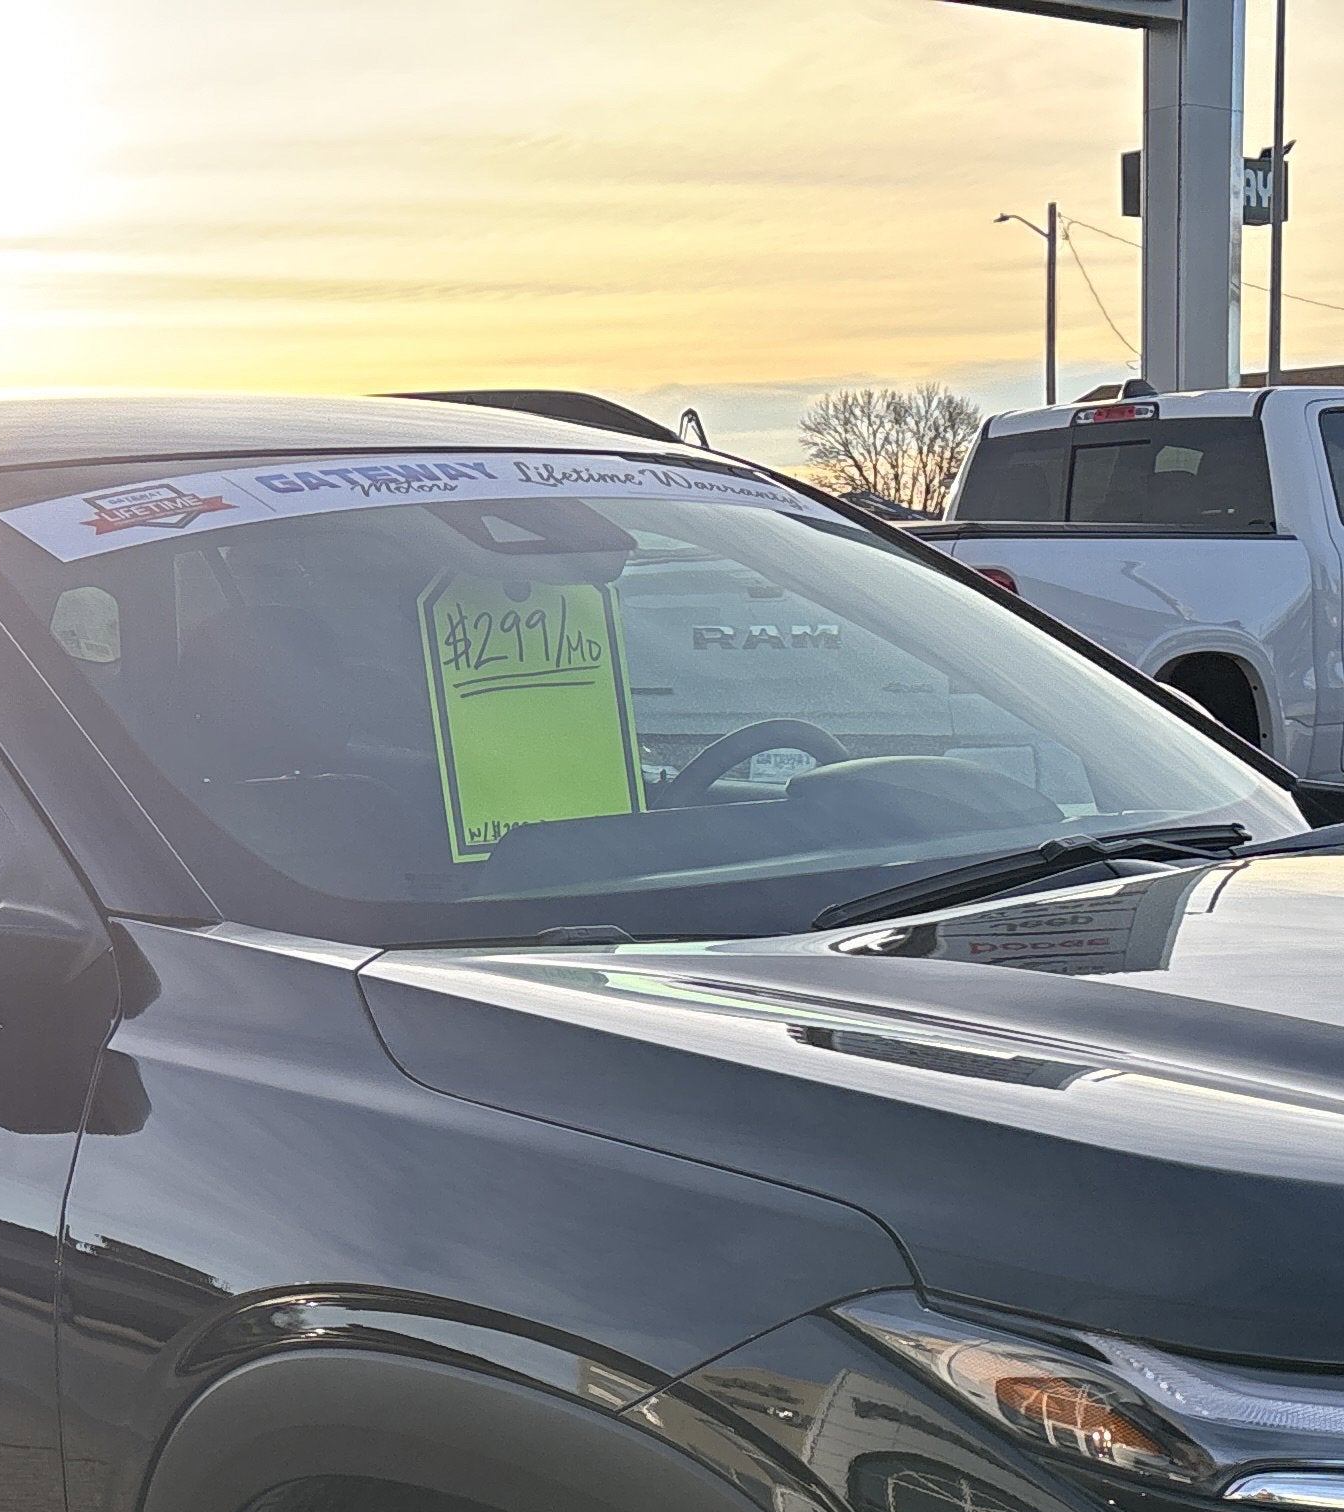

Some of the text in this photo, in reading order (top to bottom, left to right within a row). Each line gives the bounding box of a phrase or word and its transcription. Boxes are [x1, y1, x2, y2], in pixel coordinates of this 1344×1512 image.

[255, 461, 805, 511] GATEWAY Lifetime Warranty
[351, 479, 458, 497] Motors
[101, 496, 204, 522] LIFETIME
[692, 624, 842, 649] RAM
